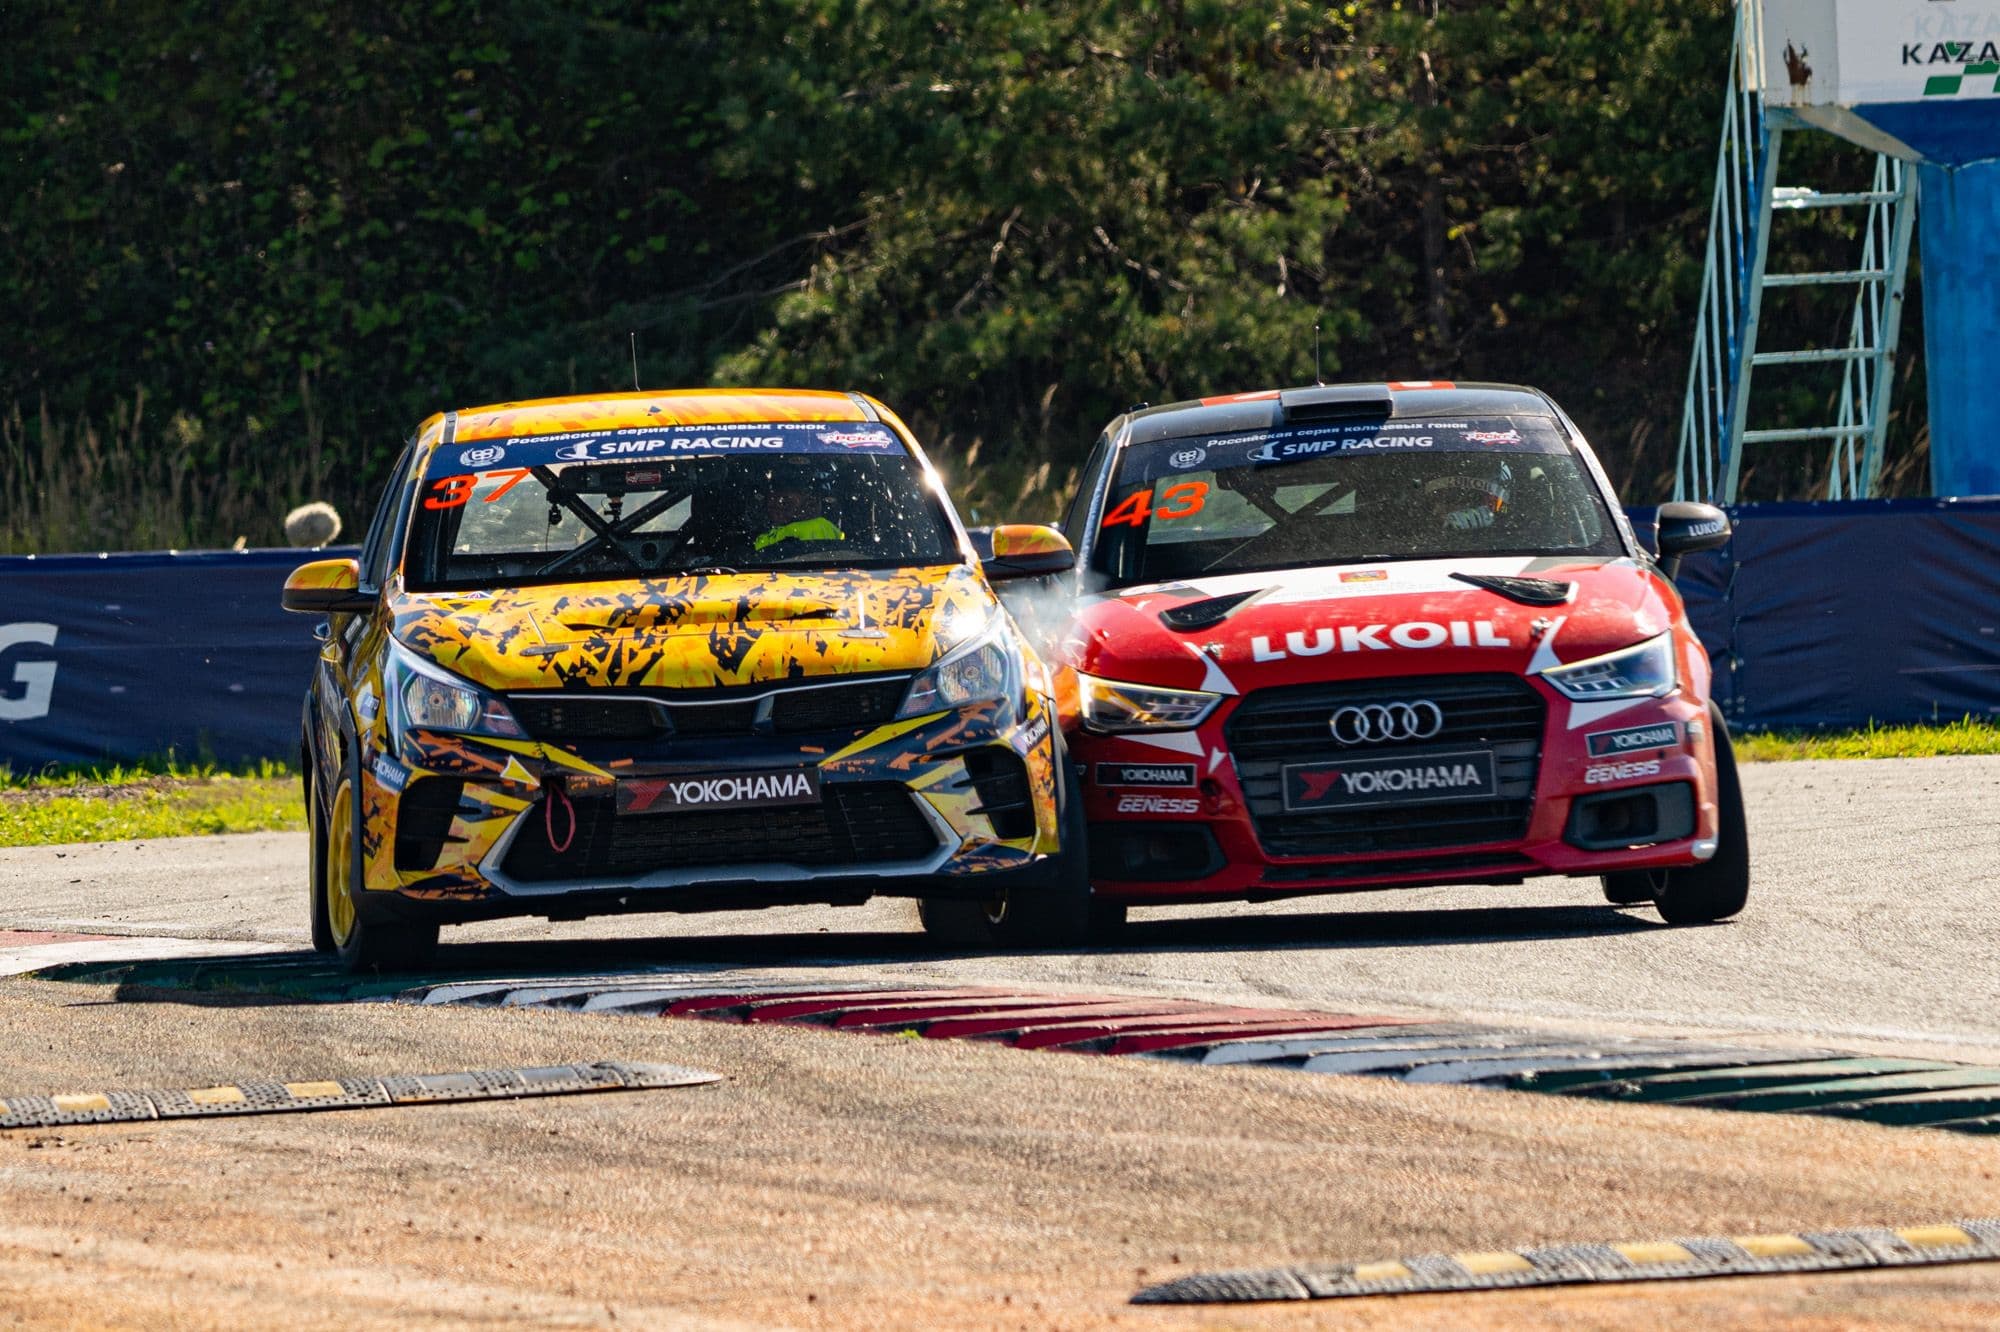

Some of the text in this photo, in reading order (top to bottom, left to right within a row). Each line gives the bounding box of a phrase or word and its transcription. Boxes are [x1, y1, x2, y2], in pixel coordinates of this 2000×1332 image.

[506, 423, 826, 446] Российская серия кольцевых гонок
[600, 437, 784, 455] SMP RACING
[1206, 422, 1468, 448] Российская серия кольцевых гонок
[1282, 436, 1433, 456] SMP RACING
[424, 467, 532, 510] 37
[1102, 481, 1209, 528] 43
[1688, 520, 1722, 537] LUKO
[1251, 620, 1511, 663] LUKOIL
[1612, 728, 1676, 749] YOKOHAMA
[1121, 768, 1188, 782] YOKOHAMA
[1341, 764, 1482, 794] YOKOHAMA
[1584, 760, 1661, 784] GENESIS
[669, 773, 812, 804] YOKOHAMA
[1117, 798, 1200, 813] GENESIS
